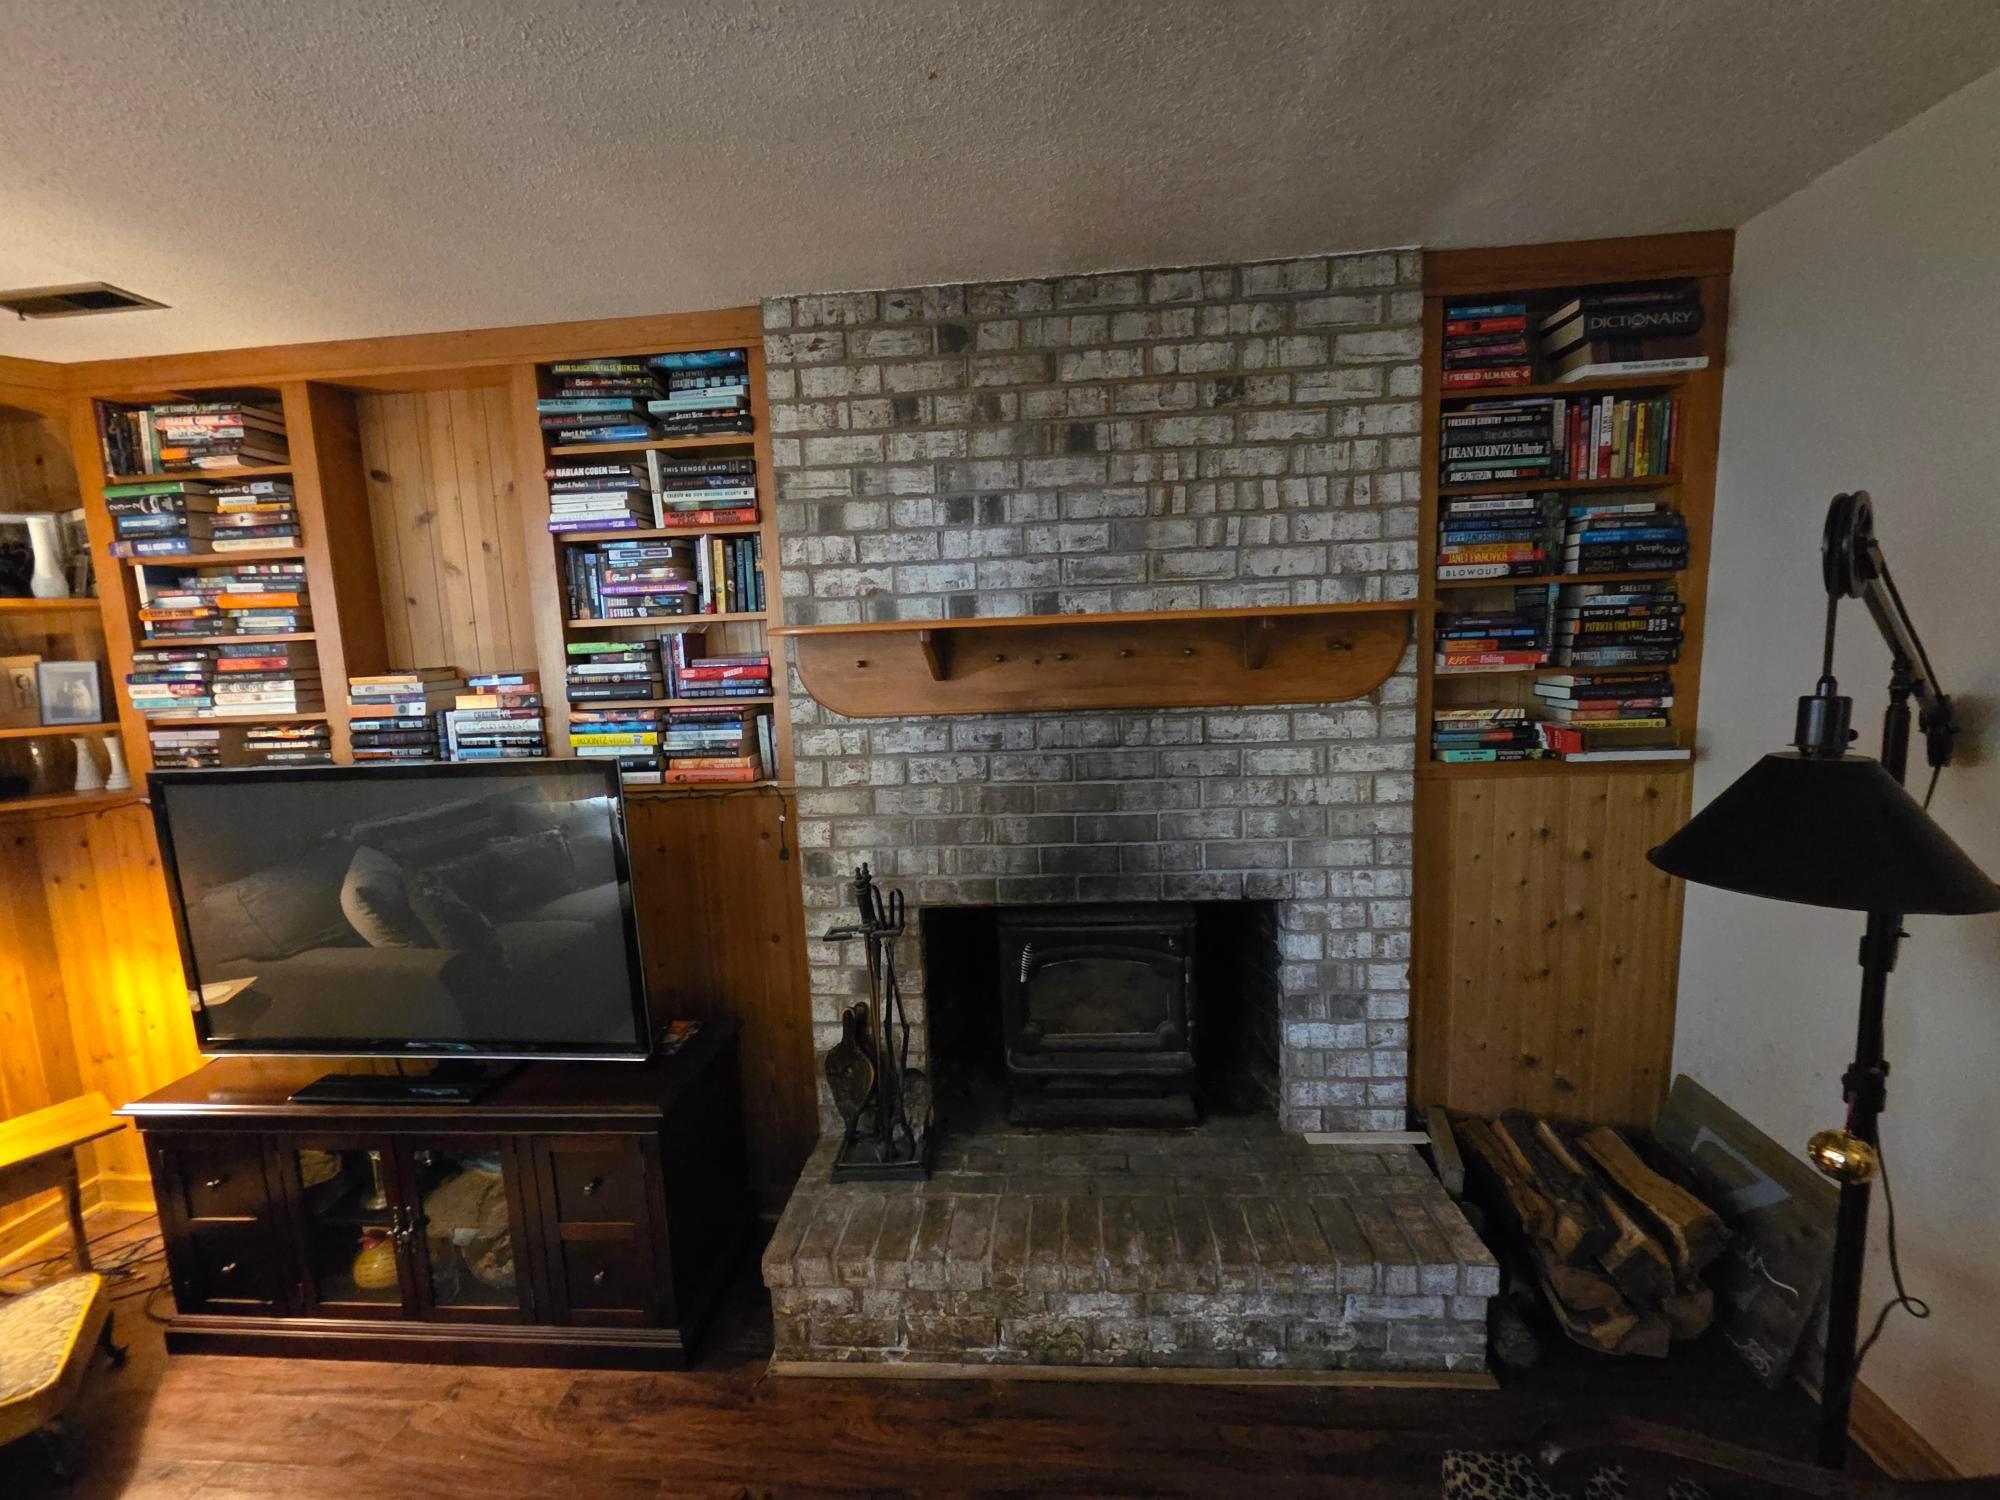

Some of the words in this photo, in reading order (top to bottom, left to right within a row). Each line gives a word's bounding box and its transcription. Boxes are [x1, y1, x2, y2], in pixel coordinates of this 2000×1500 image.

[1591, 311, 1693, 329] DICTIONARY
[1454, 372, 1481, 381] WORLD
[1482, 370, 1520, 380] ALMANAC
[1448, 447, 1474, 459] DEAN
[1475, 444, 1511, 457] KOONTZ
[556, 468, 584, 477] HARLAN
[585, 466, 608, 476] COBEN
[1470, 551, 1508, 563] EVANOVICH
[1446, 568, 1498, 577] BLOWOUT
